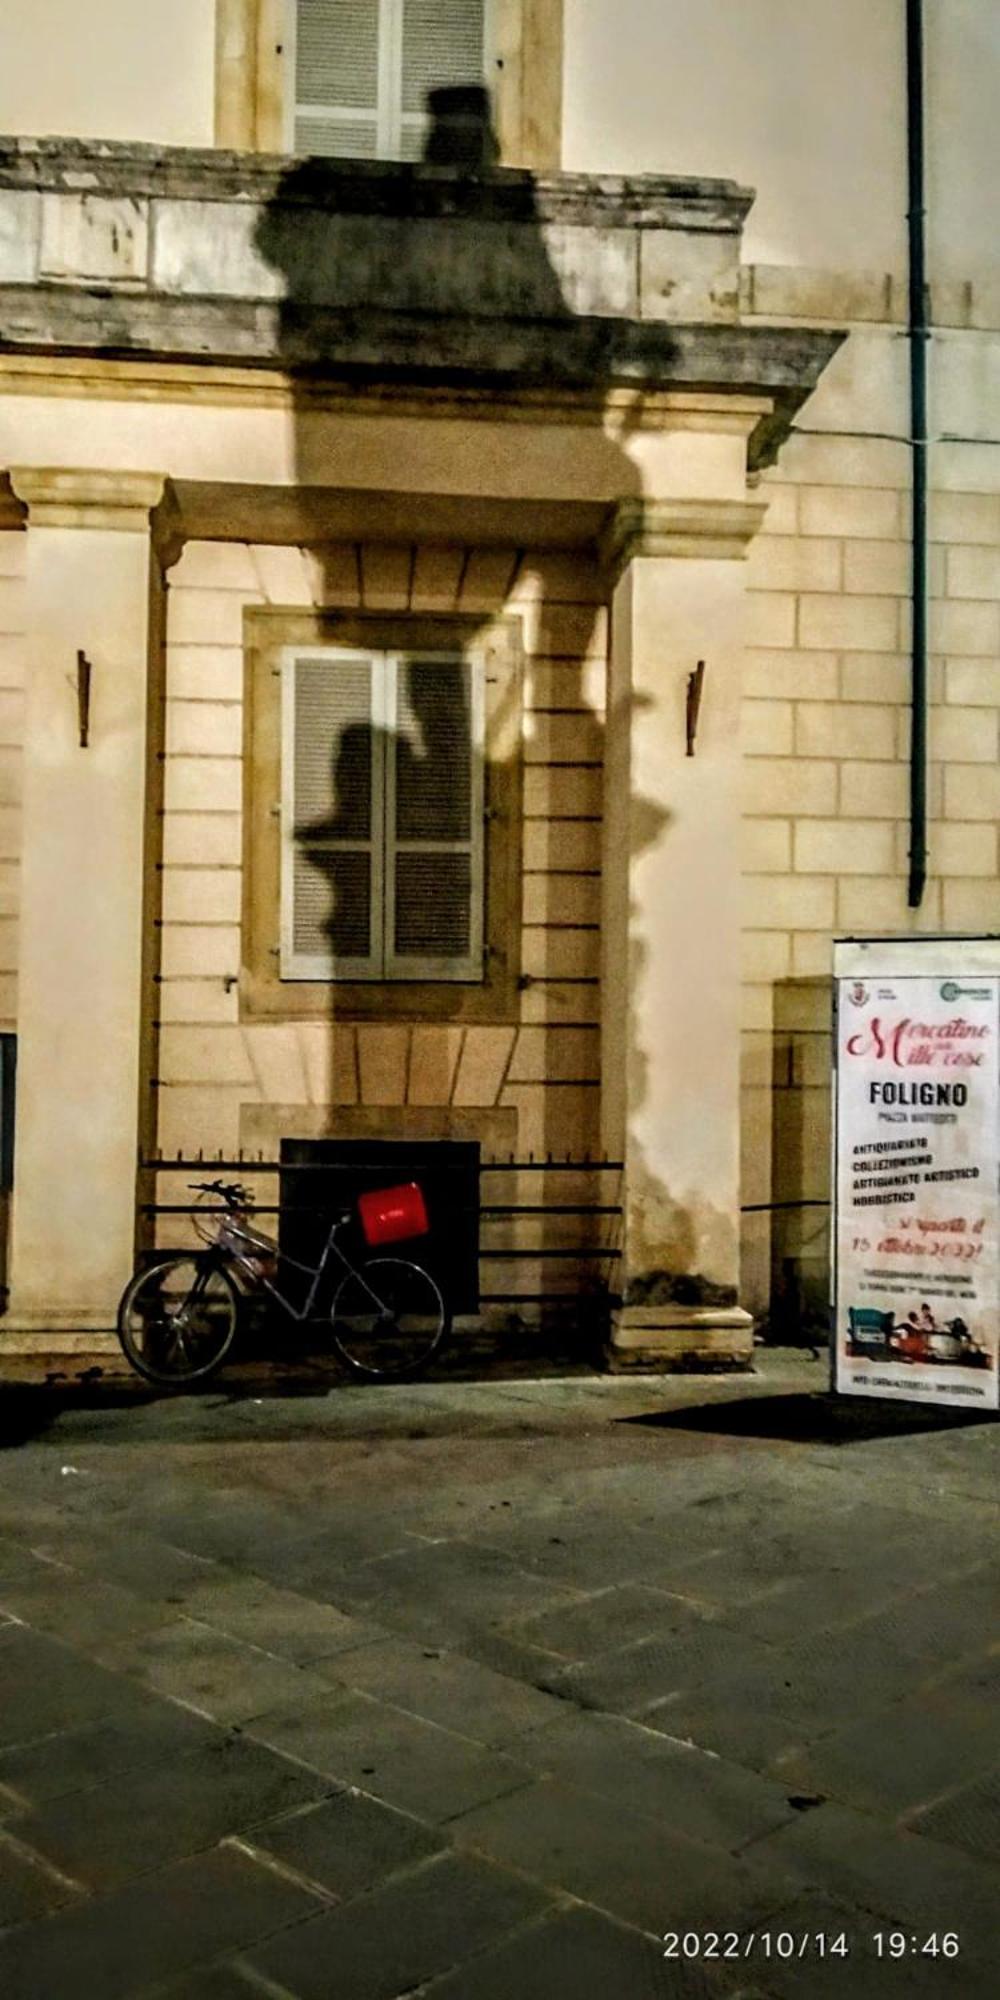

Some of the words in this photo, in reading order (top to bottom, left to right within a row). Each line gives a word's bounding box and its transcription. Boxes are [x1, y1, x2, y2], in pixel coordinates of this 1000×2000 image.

[870, 1082, 968, 1106] FOLIGNO
[853, 1137, 928, 1155] ANTIQUARIATO
[853, 1154, 933, 1173] COLLEZIONISMO
[853, 1173, 920, 1190] ARTIGIANATO
[924, 1167, 980, 1183] ARTISTICO
[853, 1192, 915, 1207] HOBBISTICA
